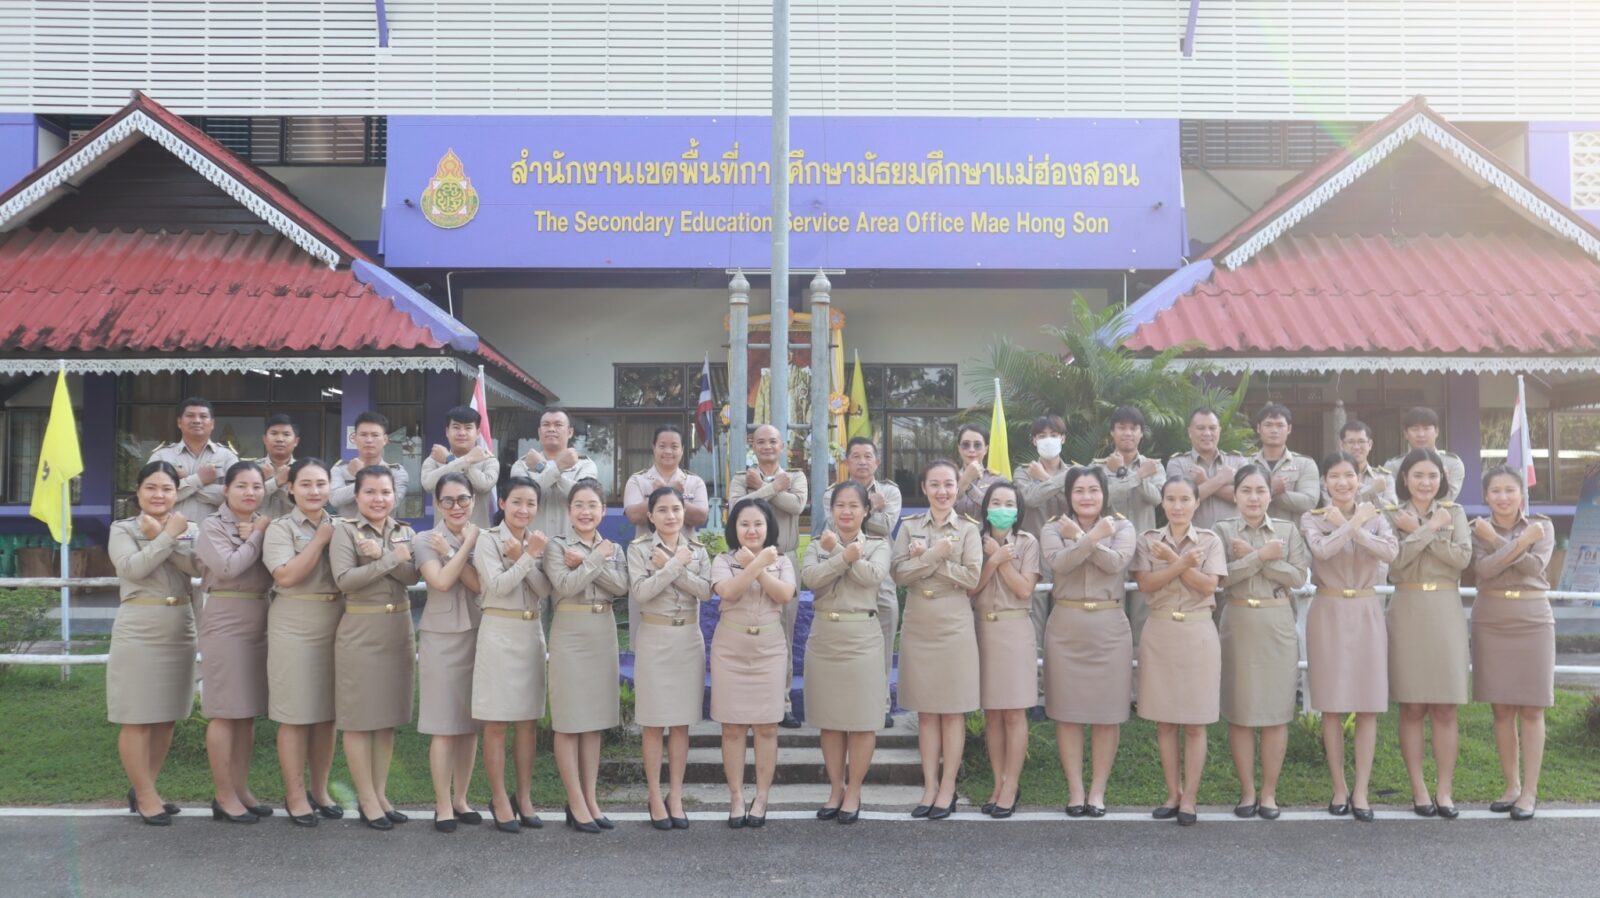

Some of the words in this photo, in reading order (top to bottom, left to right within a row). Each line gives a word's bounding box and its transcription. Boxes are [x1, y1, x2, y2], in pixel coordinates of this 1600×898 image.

[510, 138, 1140, 187] สำนักงานเขตพื้นที่กาศึกษามัธยมศึกษาแม่ฮ่องสอน
[535, 210, 568, 233] The
[574, 209, 675, 237] Secondary
[680, 210, 772, 233] Education
[856, 212, 900, 233] Area
[905, 211, 965, 233] Office
[971, 212, 1011, 234] Mae
[1016, 212, 1066, 239] Hong
[1072, 211, 1110, 234] Son
